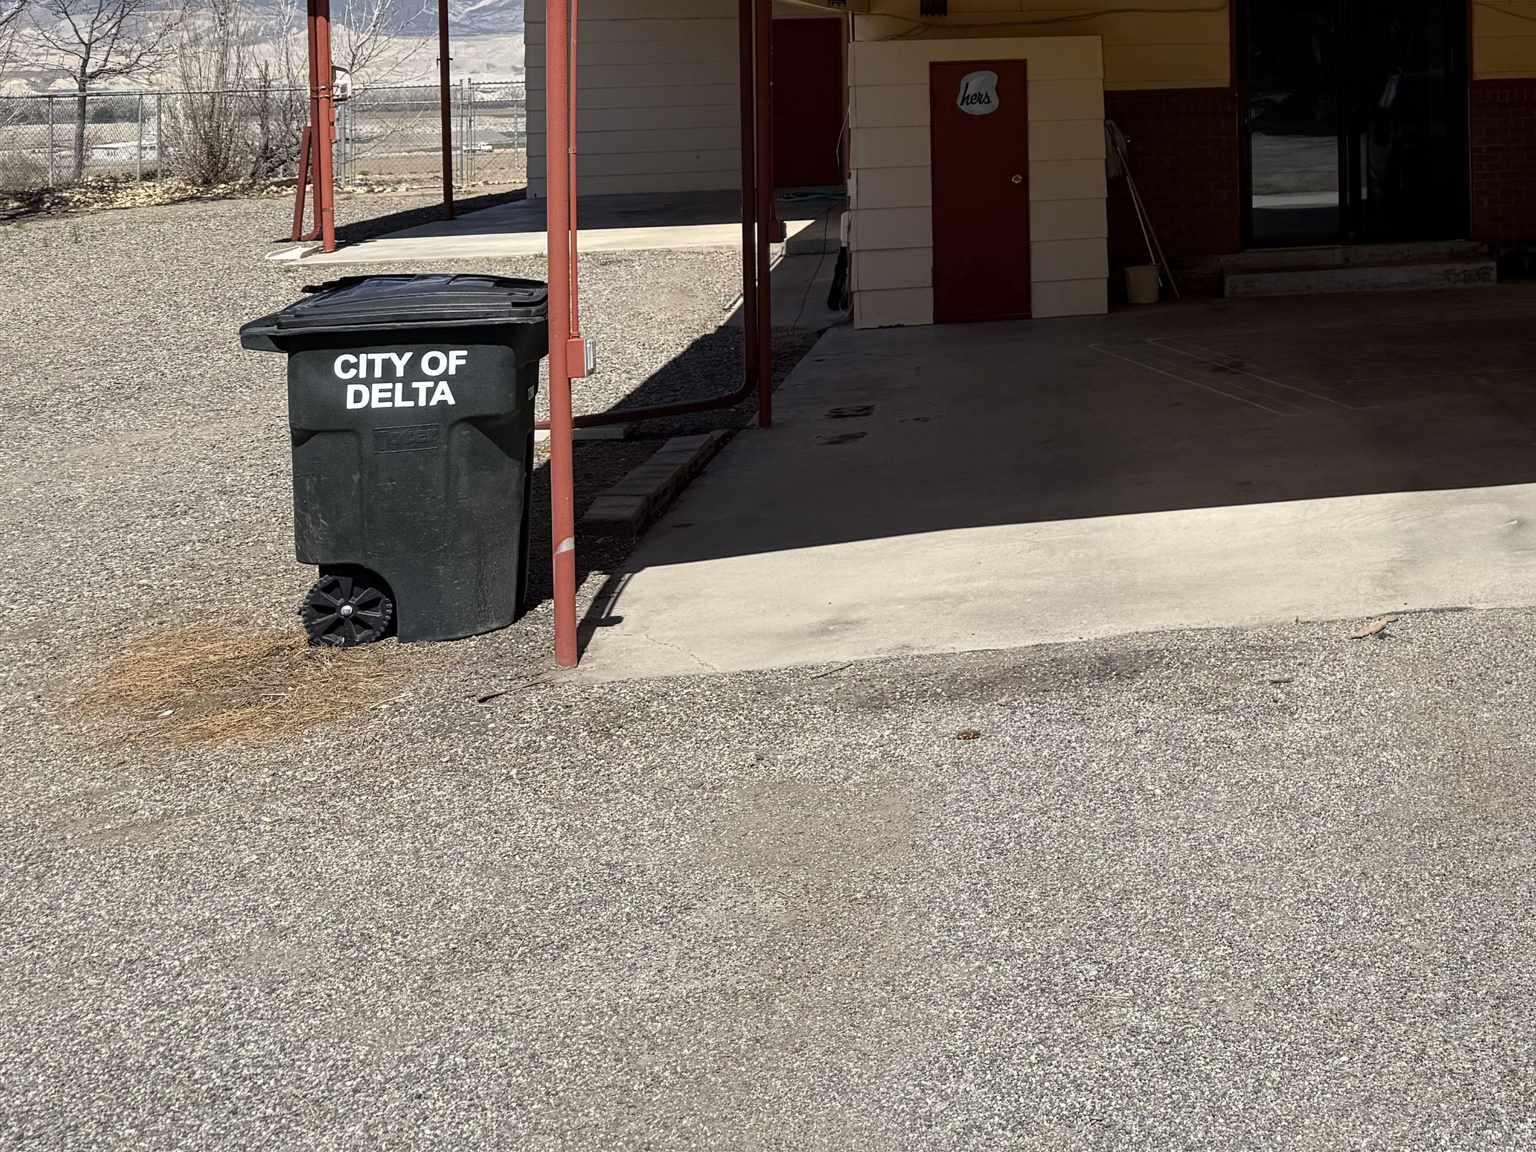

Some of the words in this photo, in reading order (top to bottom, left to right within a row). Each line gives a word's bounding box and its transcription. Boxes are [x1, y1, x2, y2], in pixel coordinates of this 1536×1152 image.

[960, 82, 991, 106] hers
[334, 352, 413, 379] CITY
[421, 350, 468, 376] OF
[346, 381, 456, 409] DELTA
